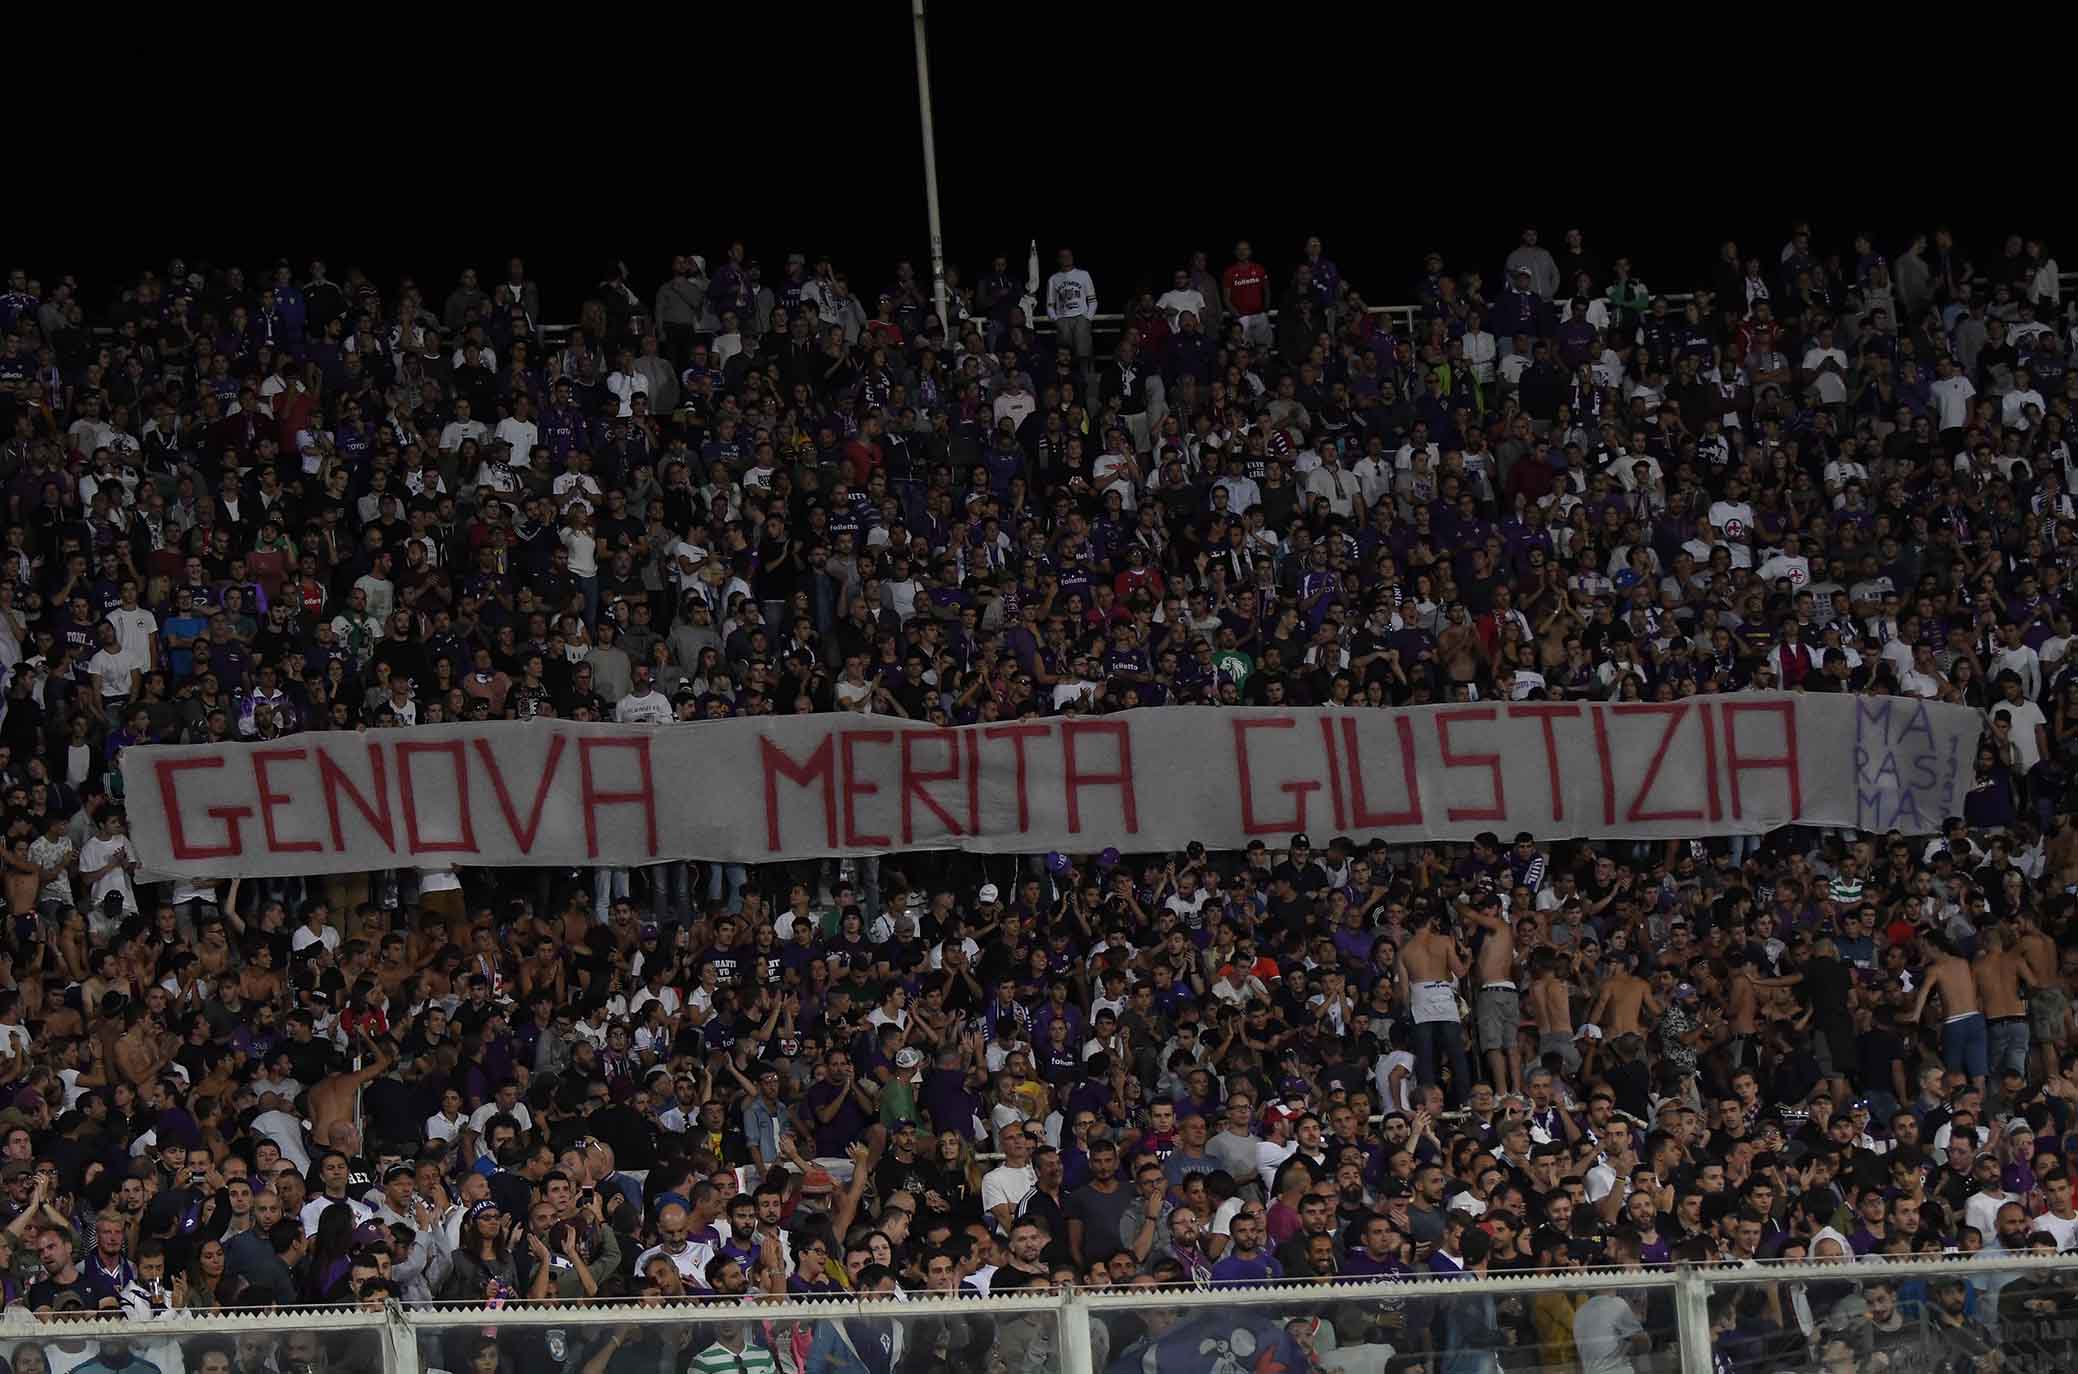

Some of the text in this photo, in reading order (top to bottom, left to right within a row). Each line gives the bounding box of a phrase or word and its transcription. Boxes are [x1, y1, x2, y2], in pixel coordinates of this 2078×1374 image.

[1856, 696, 1936, 751] MA
[155, 700, 1800, 860] GENOVA MERITA GIUSTIZIA
[1855, 746, 1937, 790] RAS
[1856, 788, 1922, 832] MA
